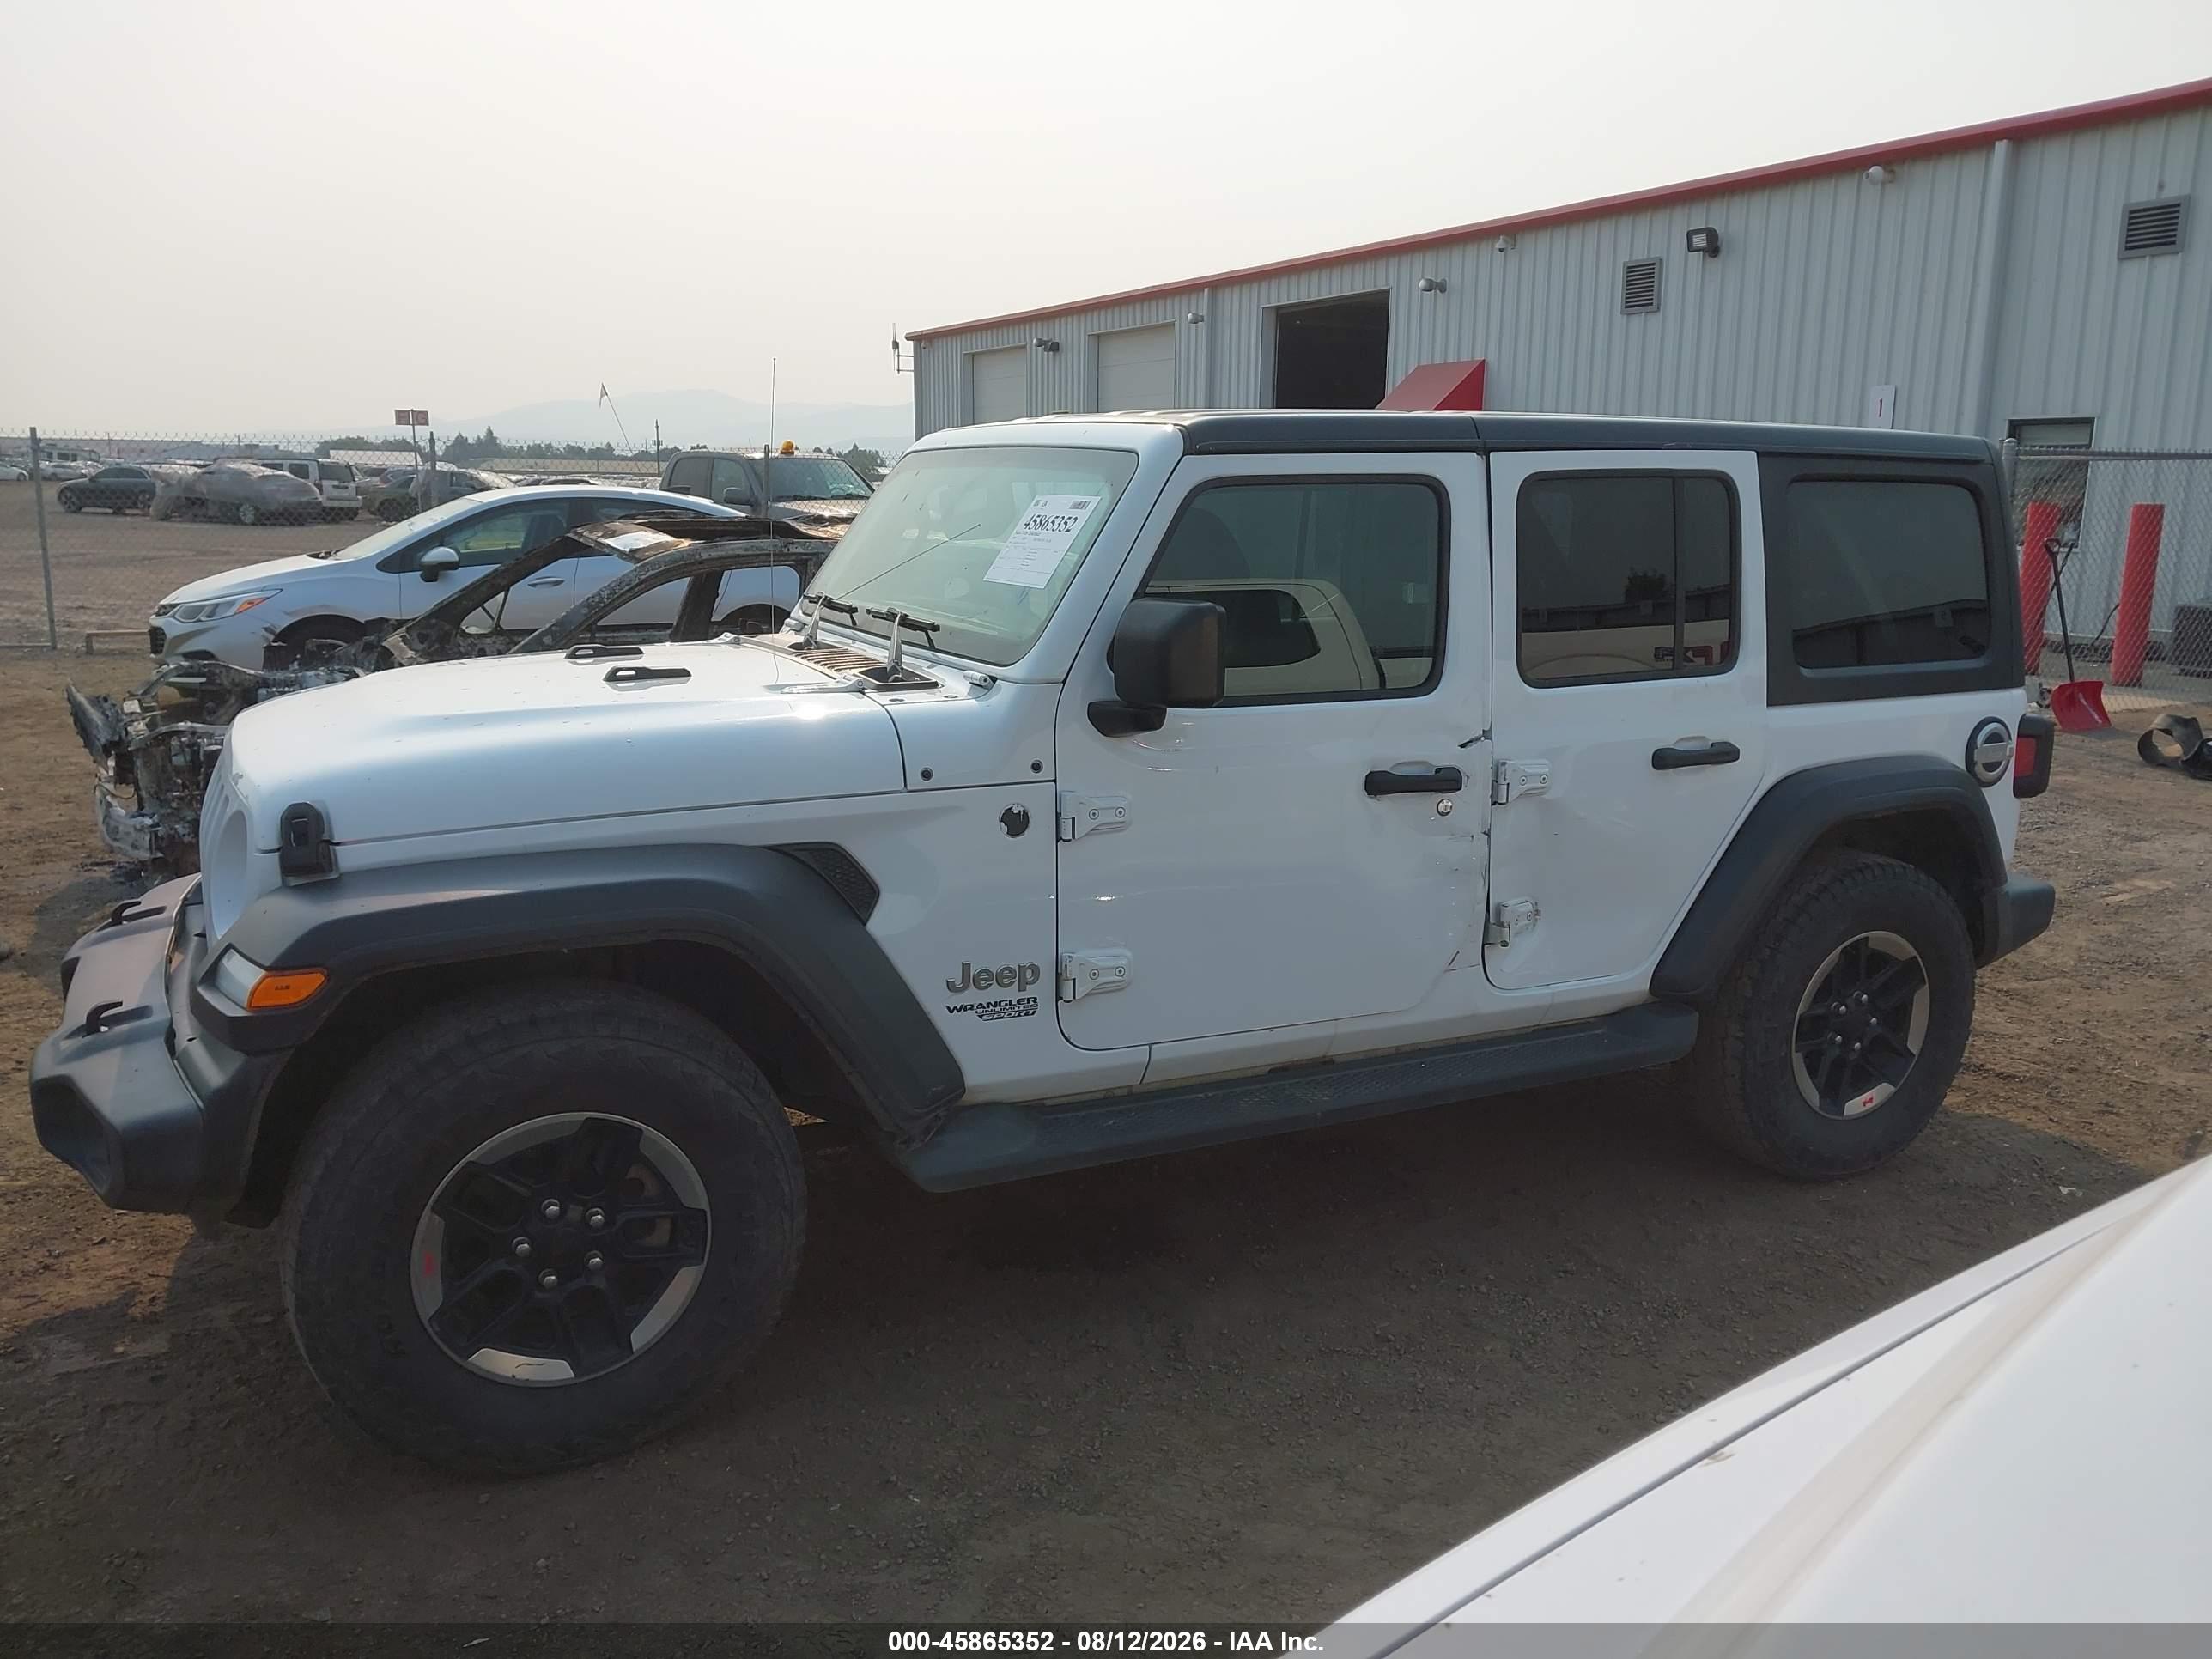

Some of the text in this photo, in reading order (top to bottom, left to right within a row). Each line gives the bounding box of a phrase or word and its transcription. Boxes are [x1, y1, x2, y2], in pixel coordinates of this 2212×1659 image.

[1878, 398, 1883, 418] 1
[1024, 514, 1079, 532] 45865352
[946, 961, 1040, 993] Jeep
[946, 997, 1037, 1014] WRANGLER
[975, 1004, 1038, 1014] UNLIMITED
[979, 1010, 1036, 1020] SPORT
